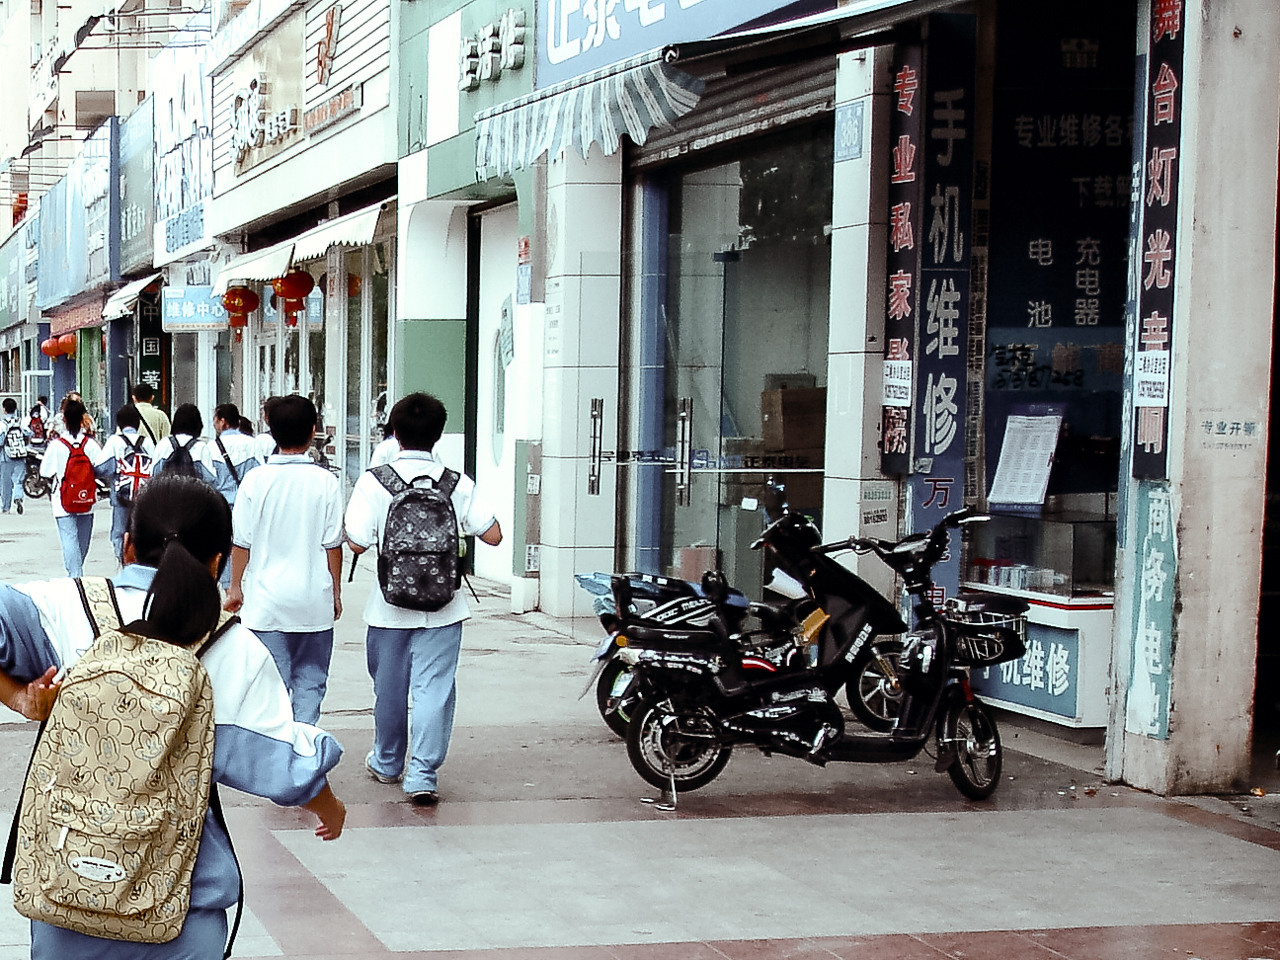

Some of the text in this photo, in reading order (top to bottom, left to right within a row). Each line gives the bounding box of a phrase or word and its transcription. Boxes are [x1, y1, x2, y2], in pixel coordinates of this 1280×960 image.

[166, 301, 225, 319] 维修中心
[923, 88, 966, 456] 手机维修
[1027, 238, 1054, 328] 电池
[1073, 237, 1102, 326] 充电器
